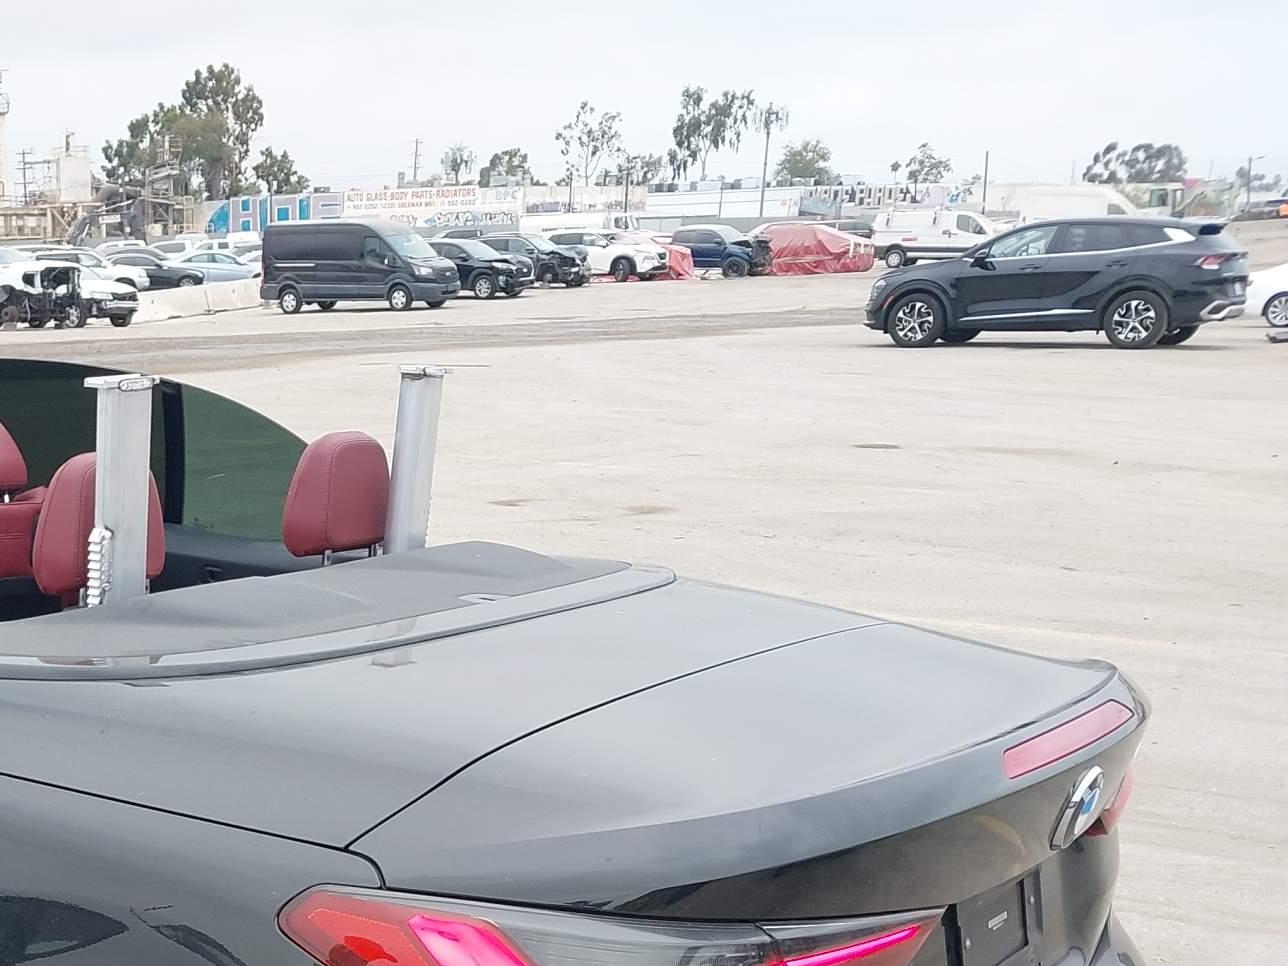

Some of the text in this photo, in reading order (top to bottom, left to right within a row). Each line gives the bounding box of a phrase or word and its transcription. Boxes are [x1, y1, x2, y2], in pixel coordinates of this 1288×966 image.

[346, 188, 476, 202] AUTO GLASS-BODY PARTS-RADIATORS
